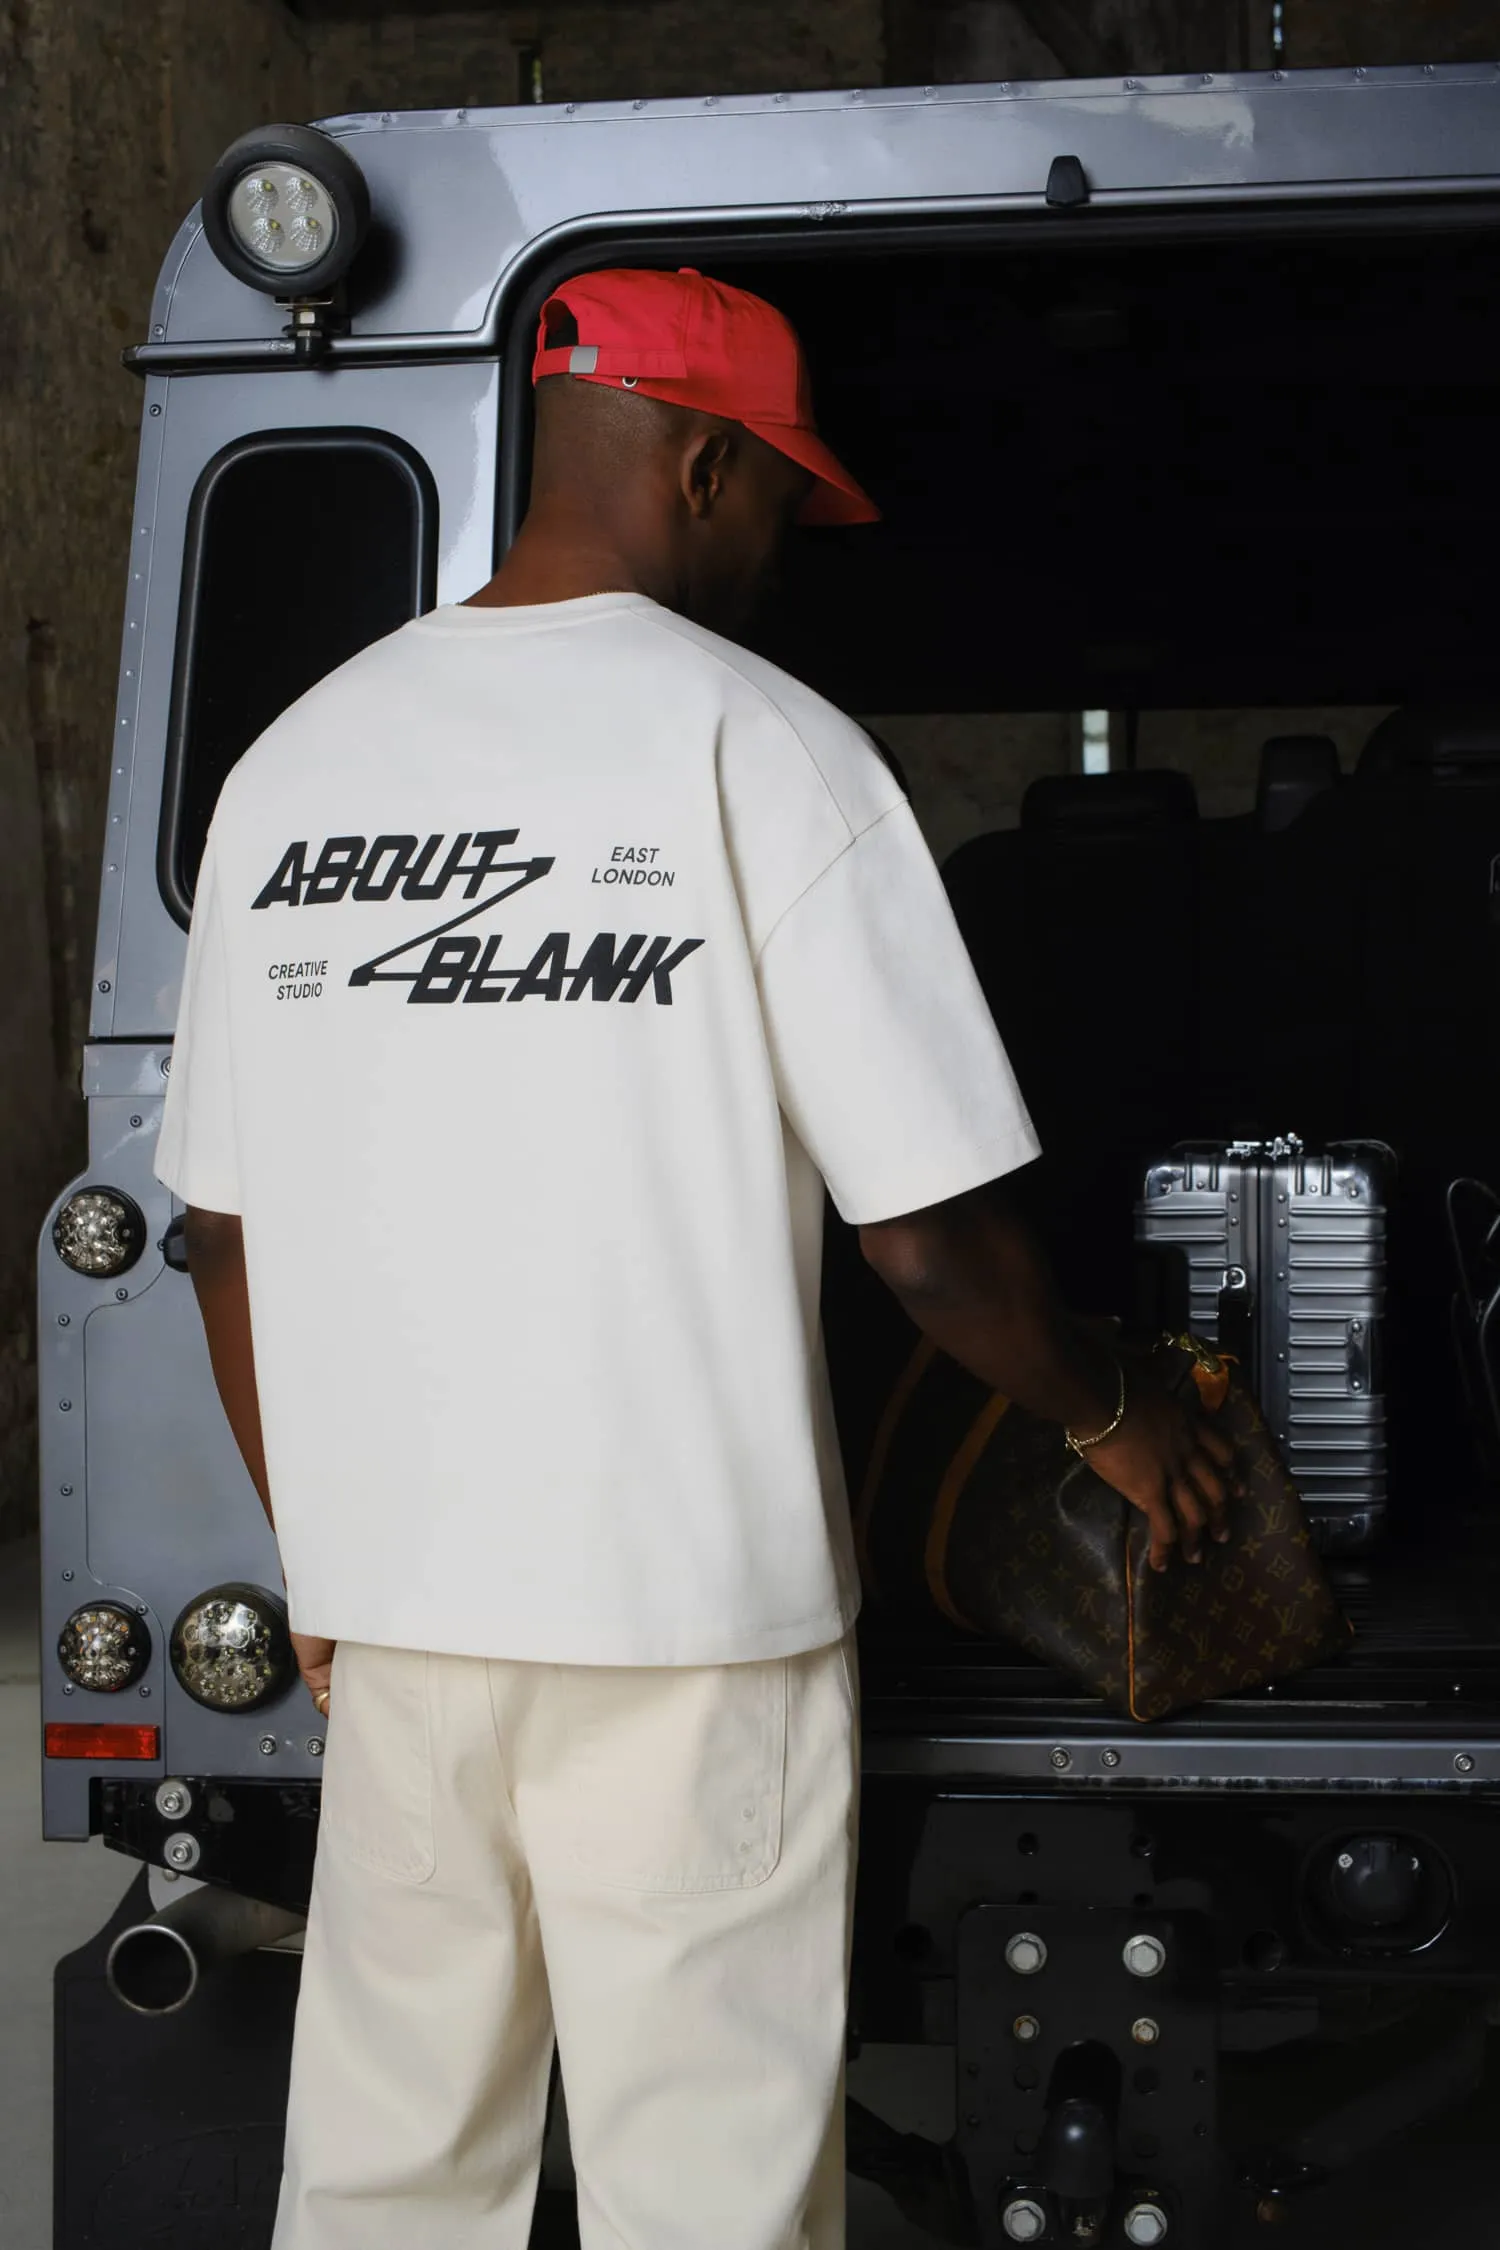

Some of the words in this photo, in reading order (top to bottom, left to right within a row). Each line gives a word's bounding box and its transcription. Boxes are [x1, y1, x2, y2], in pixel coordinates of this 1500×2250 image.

[610, 846, 661, 864] EAST
[251, 828, 521, 909] ABOUT
[591, 867, 676, 887] LONDON
[268, 960, 329, 980] CREATIVE
[406, 932, 706, 1006] BLANK
[276, 982, 323, 1001] STUDIO
